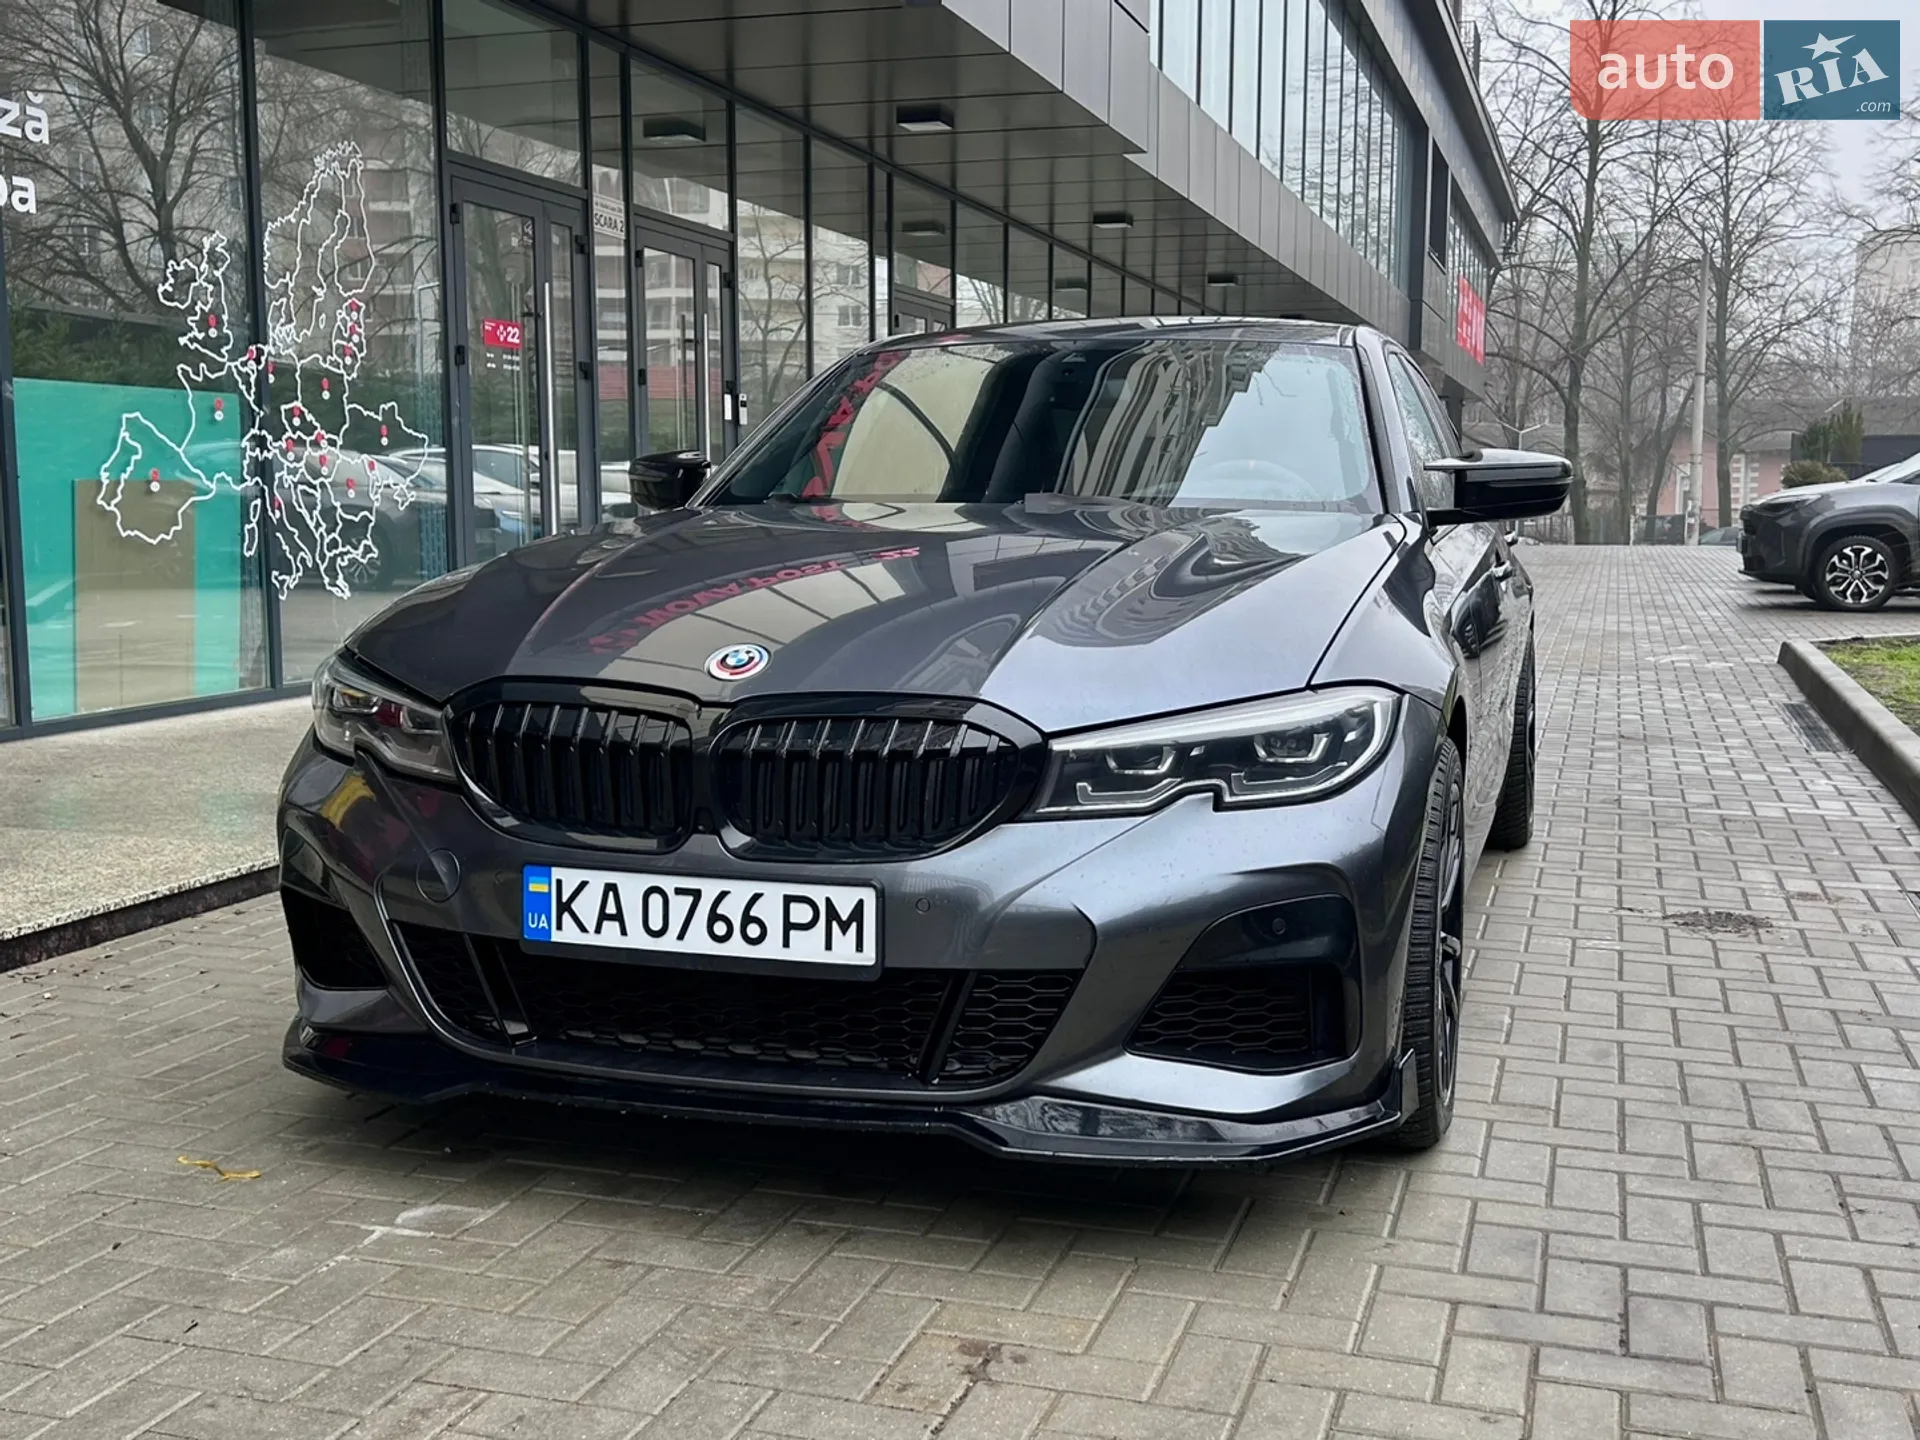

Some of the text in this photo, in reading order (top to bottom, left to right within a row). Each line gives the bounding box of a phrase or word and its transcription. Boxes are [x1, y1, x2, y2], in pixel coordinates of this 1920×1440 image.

[506, 326, 520, 344] 22
[528, 912, 549, 929] UA
[555, 878, 865, 954] KA 0766 PM
